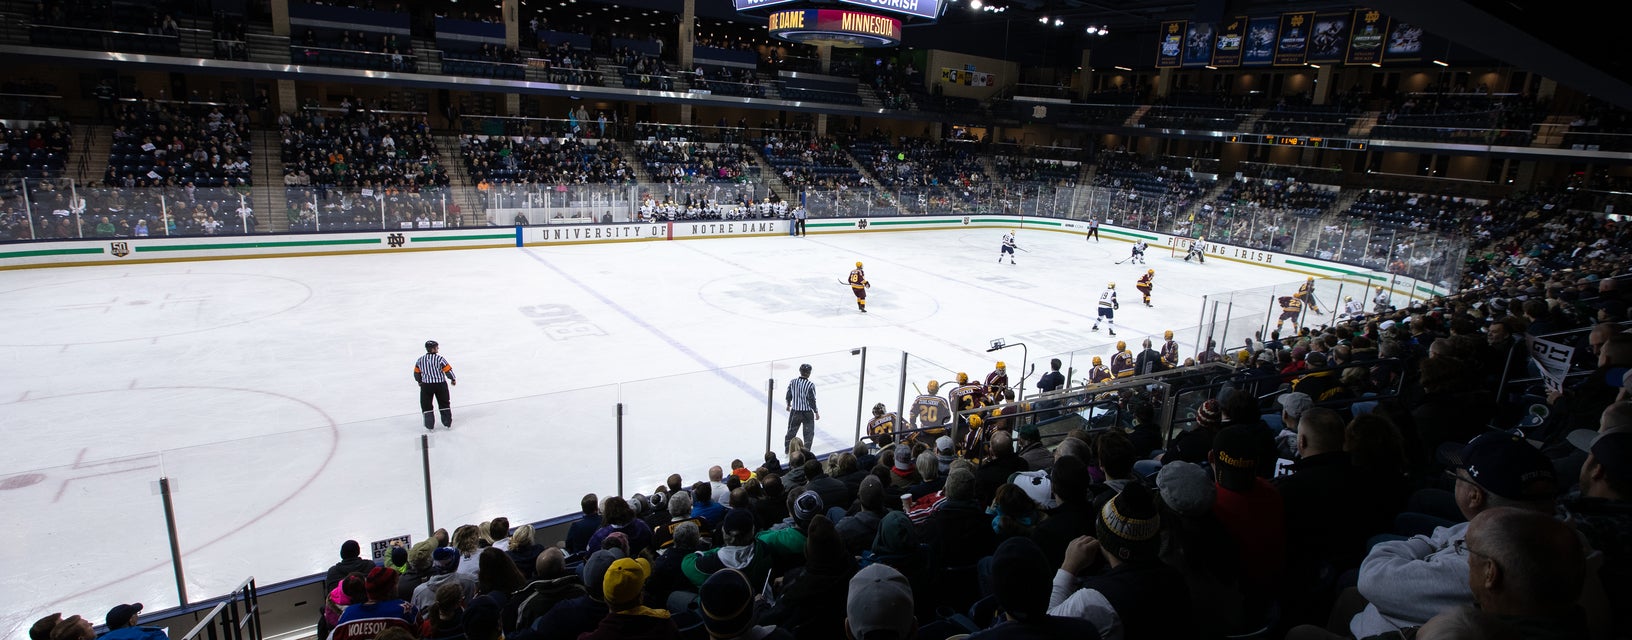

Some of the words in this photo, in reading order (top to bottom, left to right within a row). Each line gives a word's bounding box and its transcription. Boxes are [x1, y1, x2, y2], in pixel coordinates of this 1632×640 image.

[779, 11, 805, 29] DAME
[841, 12, 893, 37] MINNESOTA
[542, 226, 641, 240] UNIVERSITY
[652, 225, 667, 236] OF
[692, 223, 734, 235] NOTRE
[742, 222, 775, 233] DAME
[1167, 237, 1226, 255] FIGING
[1234, 248, 1273, 263] IRISH
[919, 404, 938, 423] 20
